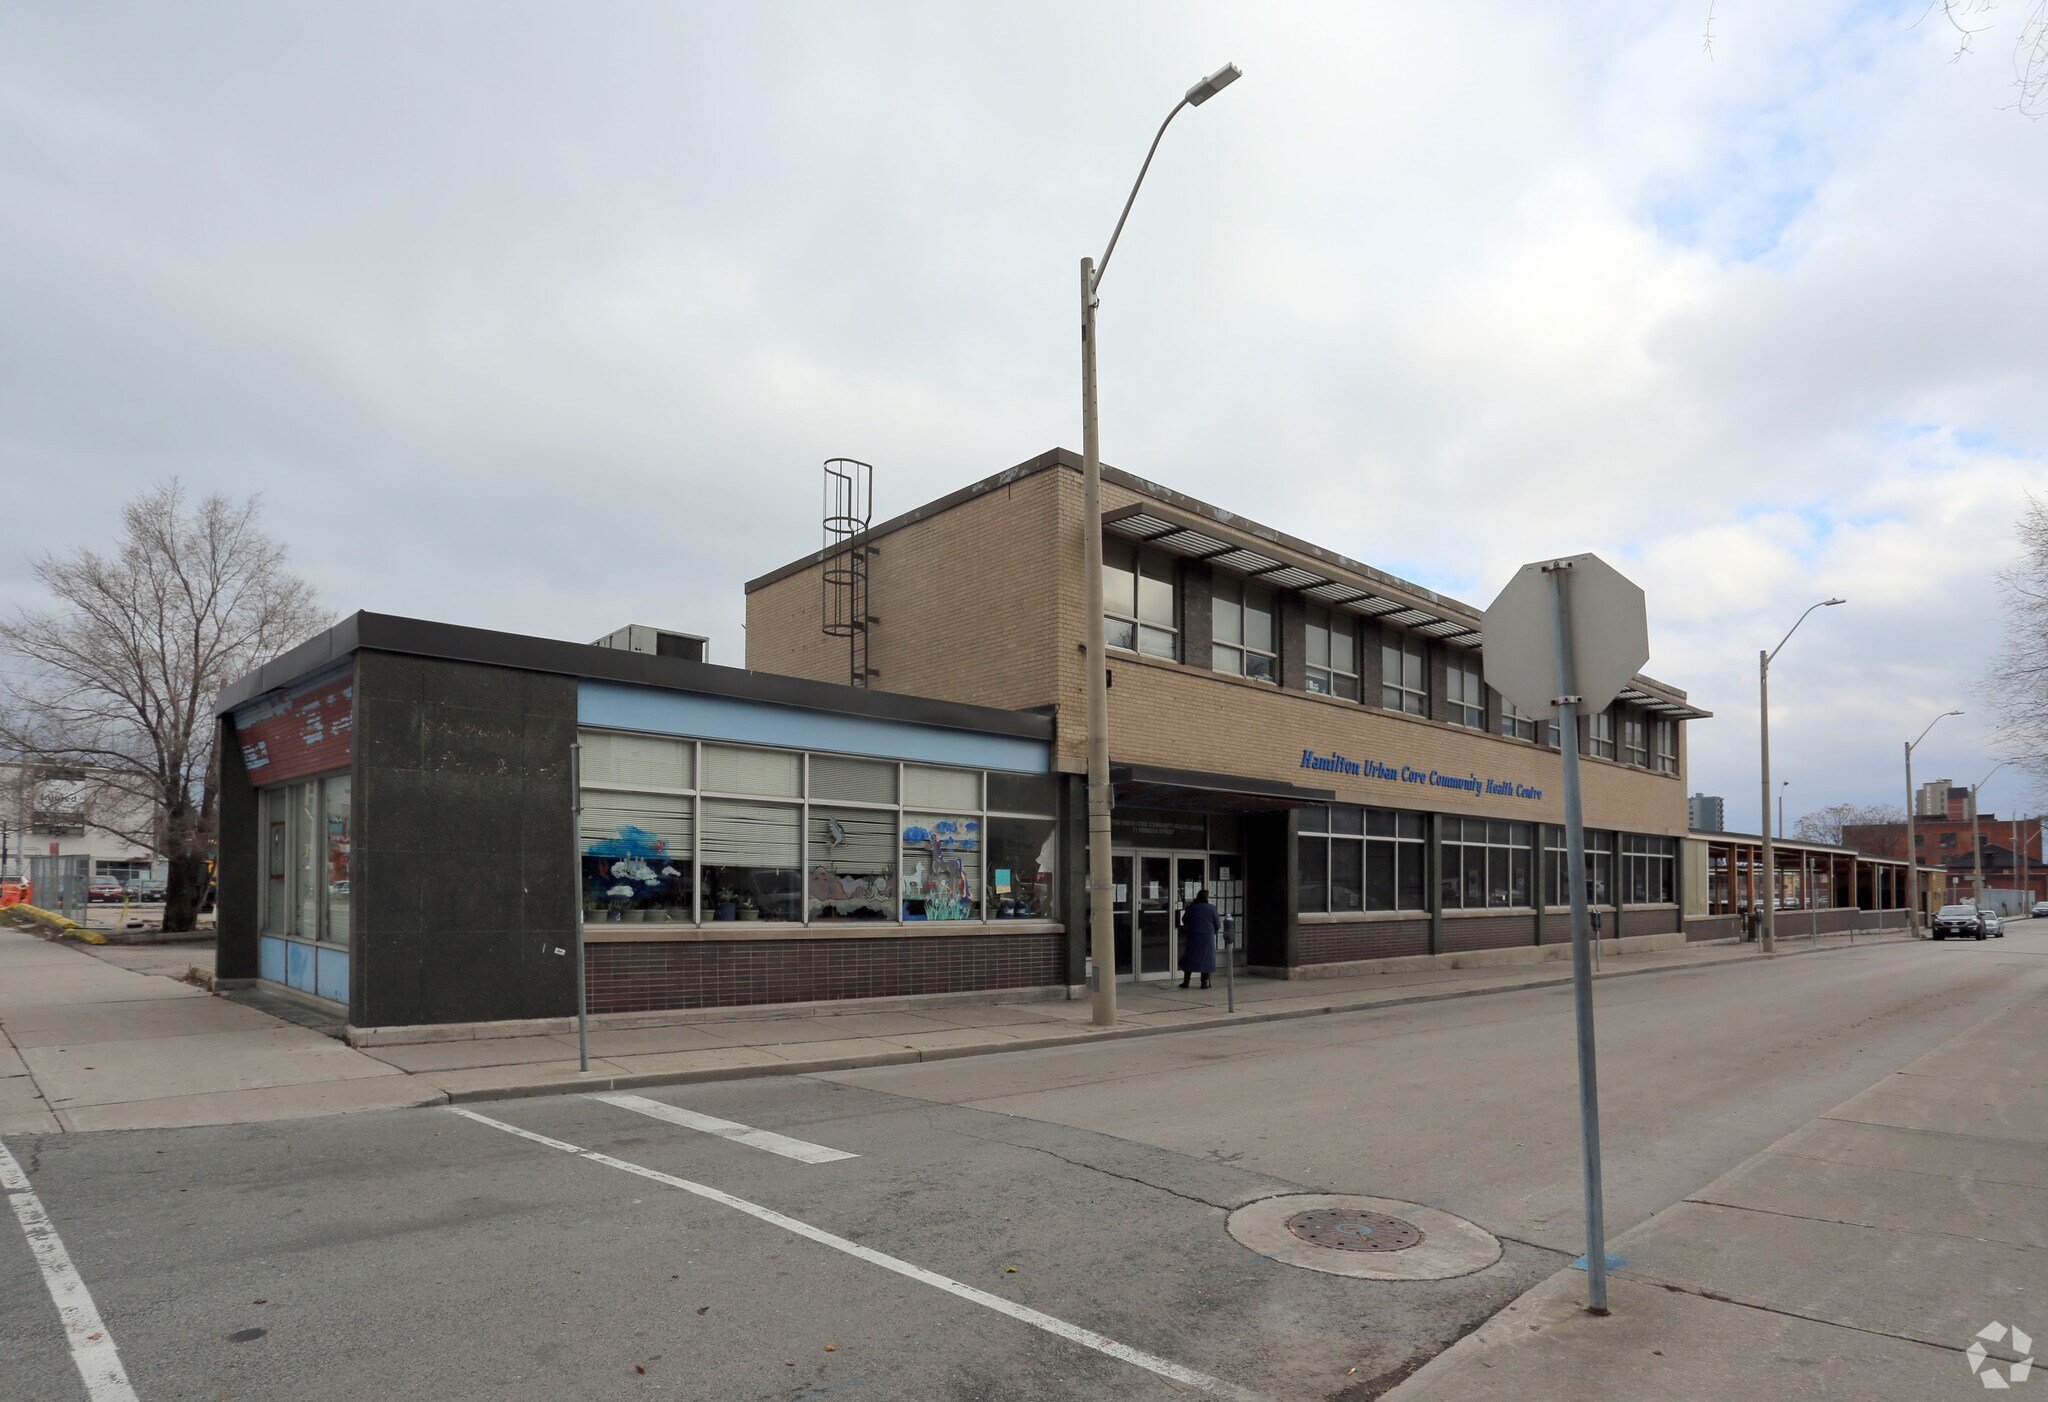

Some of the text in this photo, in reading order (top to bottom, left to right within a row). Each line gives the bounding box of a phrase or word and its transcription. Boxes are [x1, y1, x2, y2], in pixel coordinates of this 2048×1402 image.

[1301, 750, 1543, 799] Hamilton Urban Core Community Health Centre
